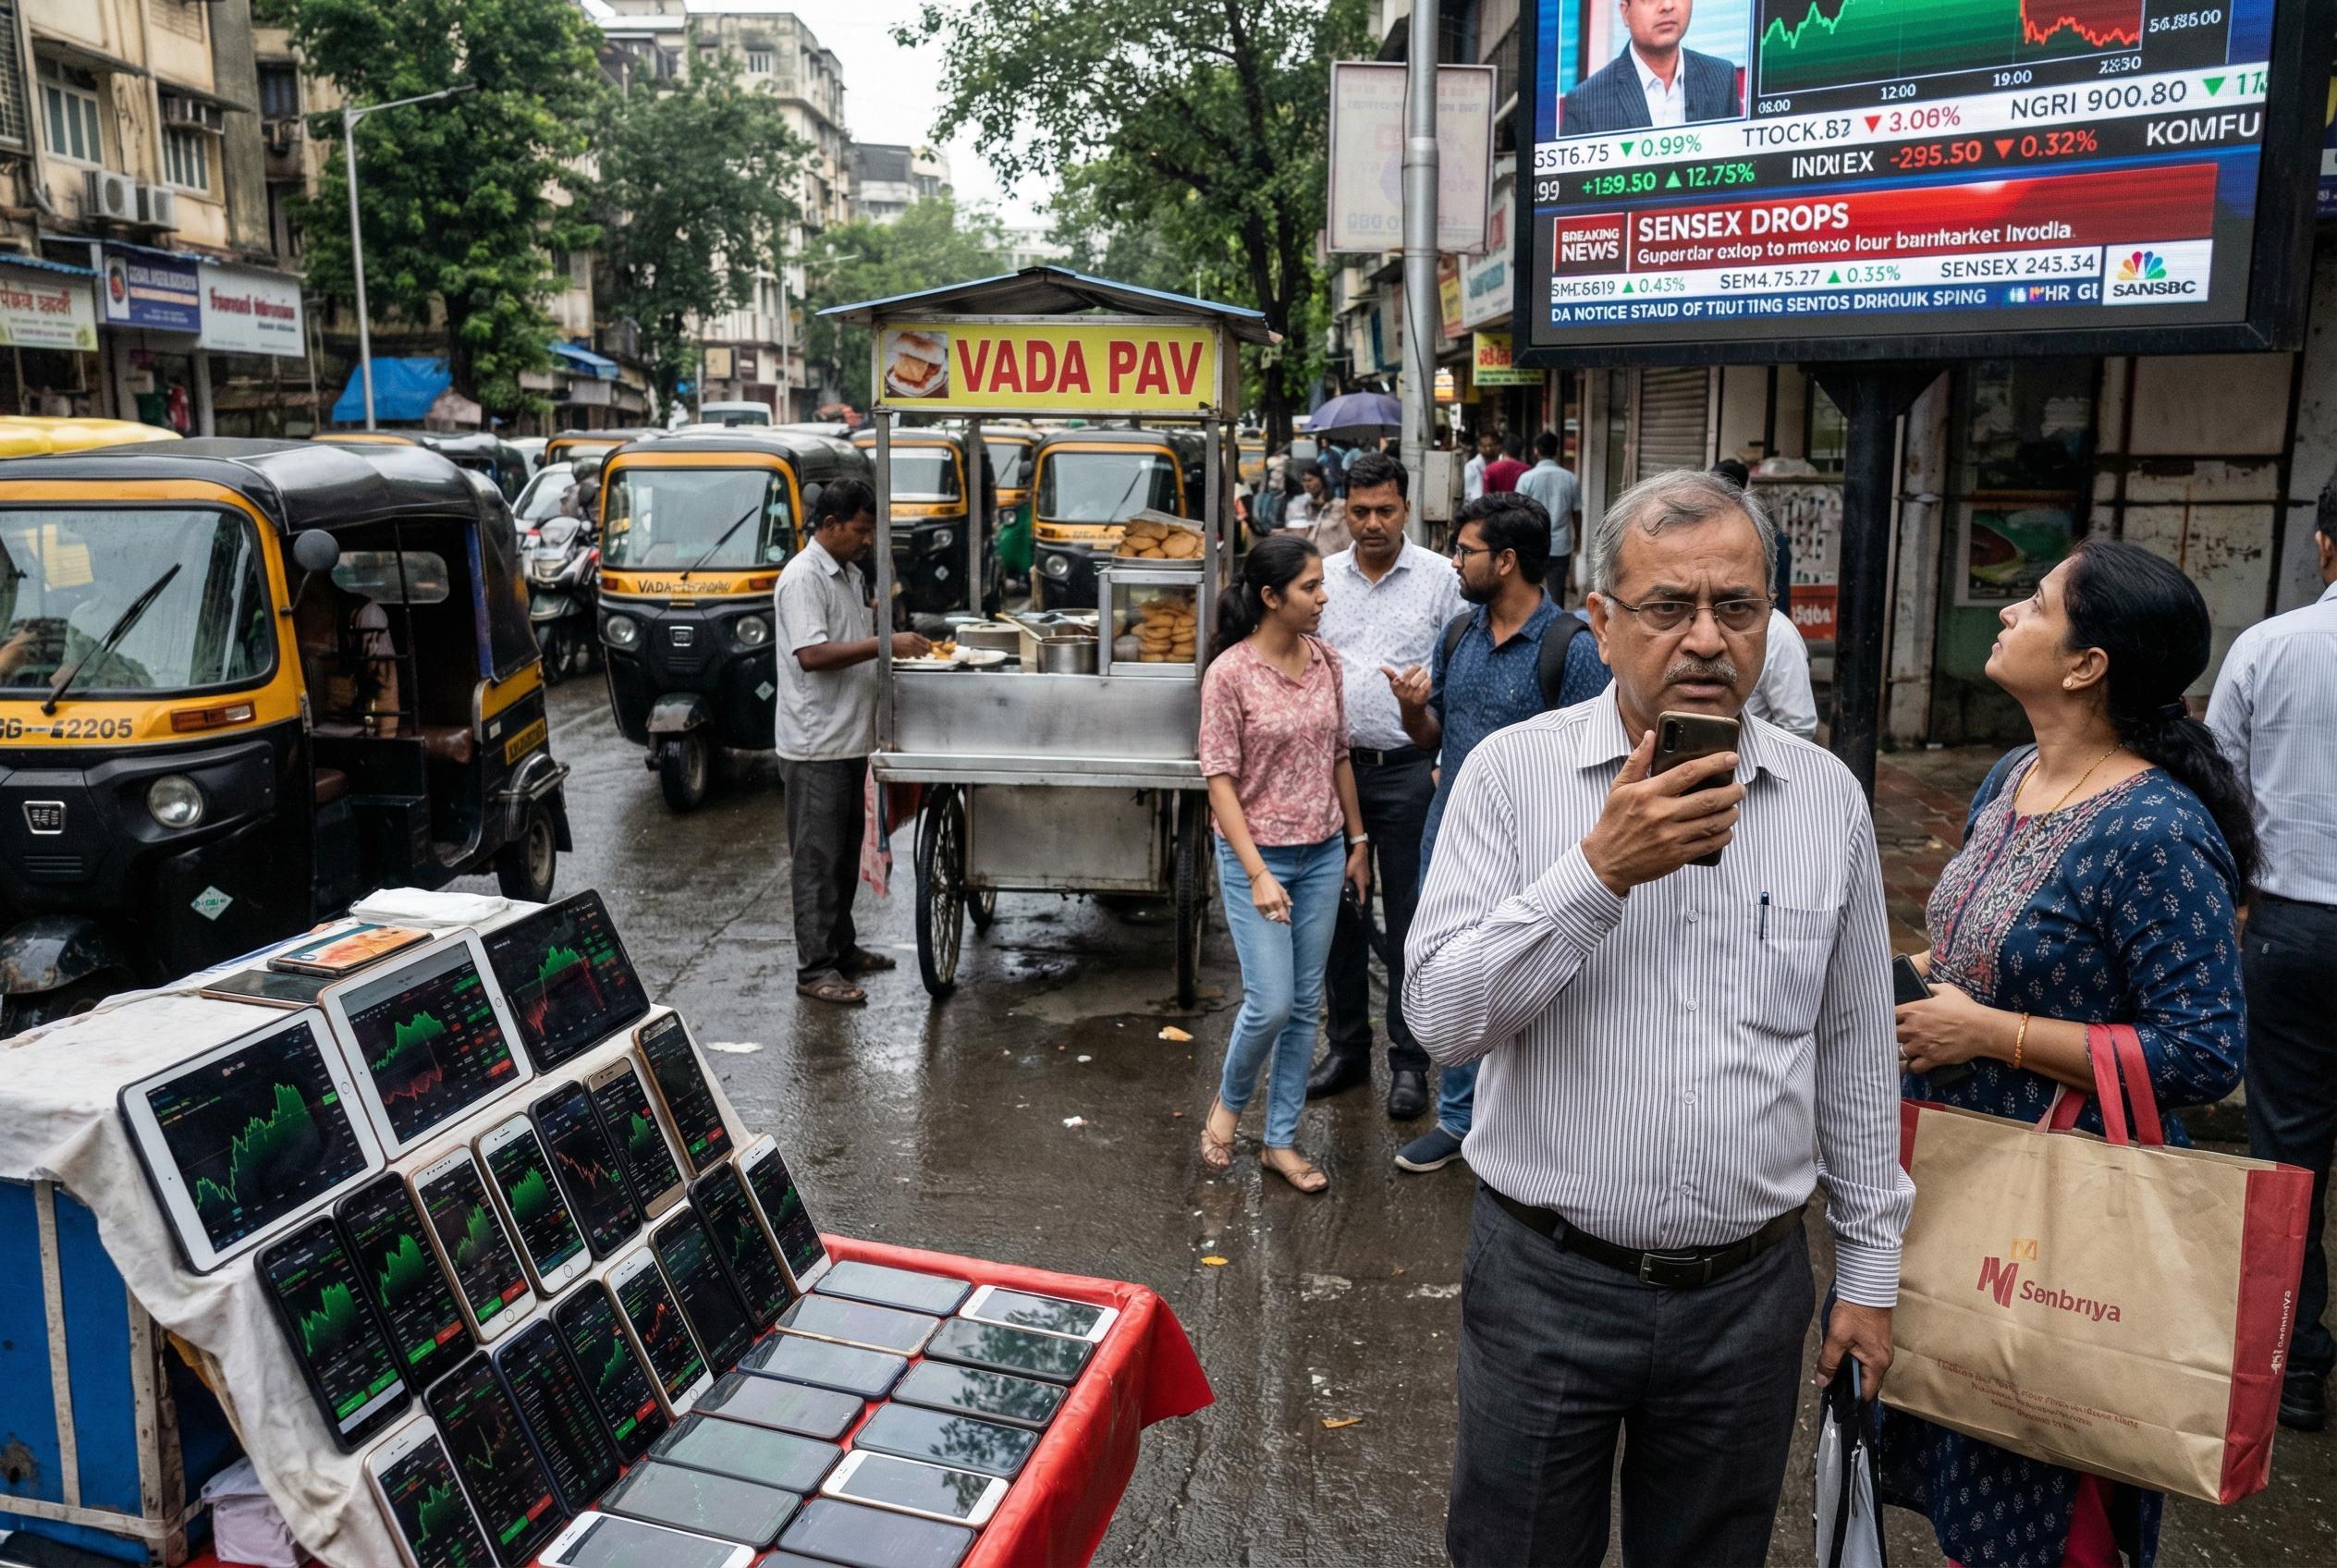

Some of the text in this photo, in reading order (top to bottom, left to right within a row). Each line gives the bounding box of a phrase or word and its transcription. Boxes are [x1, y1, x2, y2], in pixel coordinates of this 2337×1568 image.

[1640, 132, 1703, 158] 0.99%
[2011, 92, 2076, 120] NGRI
[2087, 80, 2187, 112] 900.80
[1686, 162, 1756, 188] 12.75%
[1889, 141, 1983, 169] -295.50
[2020, 129, 2098, 158] 0.32%
[2146, 111, 2261, 146] KOMFU
[1560, 228, 1620, 243] BREAKING
[1638, 202, 1850, 243] SENSEX DROPS
[1560, 241, 1620, 263] NEWS
[1767, 241, 1785, 257] to
[1940, 258, 2018, 278] SENSEX
[2112, 280, 2196, 298] SANSBC
[1551, 307, 1572, 322] DA
[1574, 304, 1628, 321] NOTICE
[1630, 302, 1679, 320] STAUD
[1682, 300, 1703, 317] OF
[1786, 295, 1850, 312] SENTOS
[1932, 288, 1988, 306] SPING
[956, 339, 1204, 396] VADA PAV
